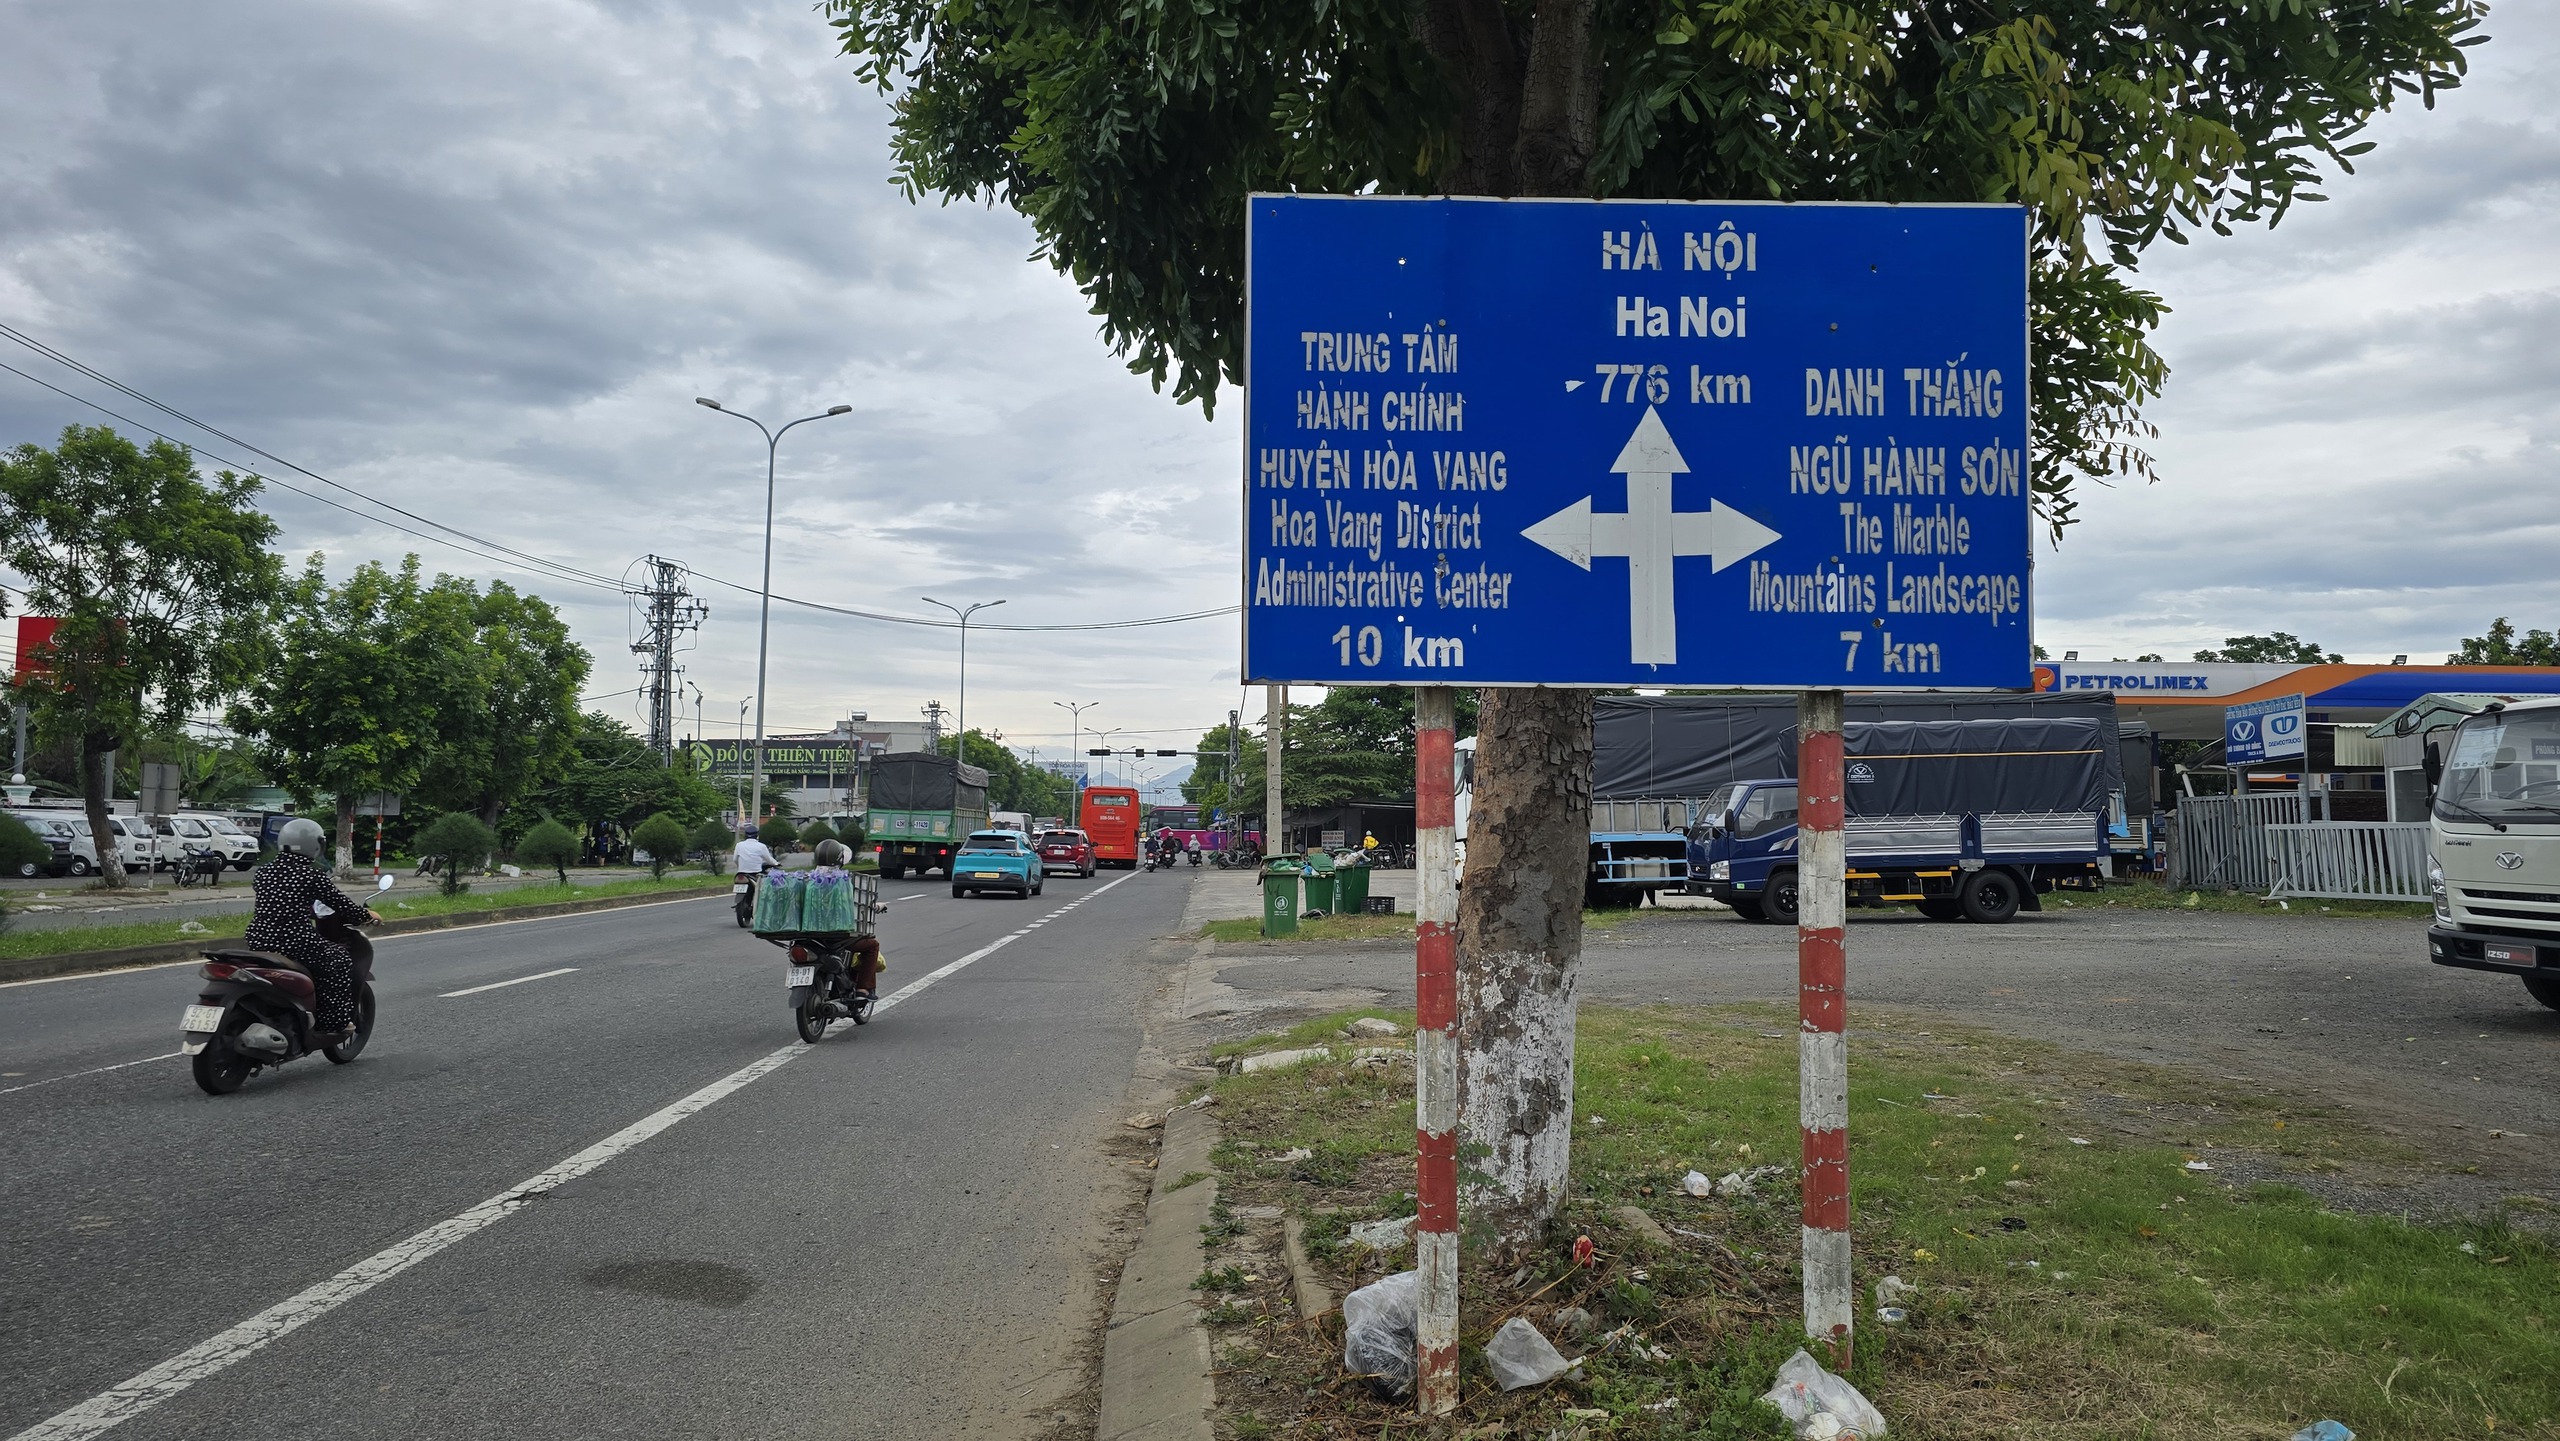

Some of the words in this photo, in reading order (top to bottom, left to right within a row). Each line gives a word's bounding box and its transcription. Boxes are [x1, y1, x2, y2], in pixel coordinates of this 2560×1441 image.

[1603, 221, 1662, 270] HÀ
[1685, 221, 1756, 280] NỘI
[1302, 332, 1390, 372] TRUNG
[1403, 324, 1457, 372] TÂM
[1298, 381, 1368, 430] HÀNH
[1382, 383, 1462, 431] CHÍNH
[1596, 365, 1669, 403] 776
[1691, 365, 1750, 403] km
[1806, 369, 1883, 415] DANH
[1905, 352, 2002, 417] THẮNG
[1261, 440, 1350, 497] HUYỆN
[1364, 440, 1417, 490] HÒA
[1433, 451, 1506, 491] VANG
[1791, 434, 1850, 494] NGŨ
[1864, 437, 1945, 495] HÀNH
[1961, 438, 2018, 496] SƠN
[1272, 499, 1316, 547] Hoa
[1326, 500, 1381, 561] Vang
[1398, 501, 1481, 549] District
[1840, 503, 1882, 553] The
[1894, 503, 1969, 554] Marble
[1255, 558, 1423, 607] Administrative
[1435, 562, 1512, 609] Center
[1750, 561, 1875, 613] Mountains
[1888, 562, 2019, 626] Landscape
[1333, 626, 1382, 666] 10
[1404, 626, 1463, 667] km
[1841, 631, 1862, 671] 7
[1884, 633, 1940, 672] km
[2065, 675, 2208, 690] PETROLIMEX
[716, 742, 738, 762] ĐỒ
[768, 745, 816, 762] THIÊN
[820, 742, 856, 762] TIẾN
